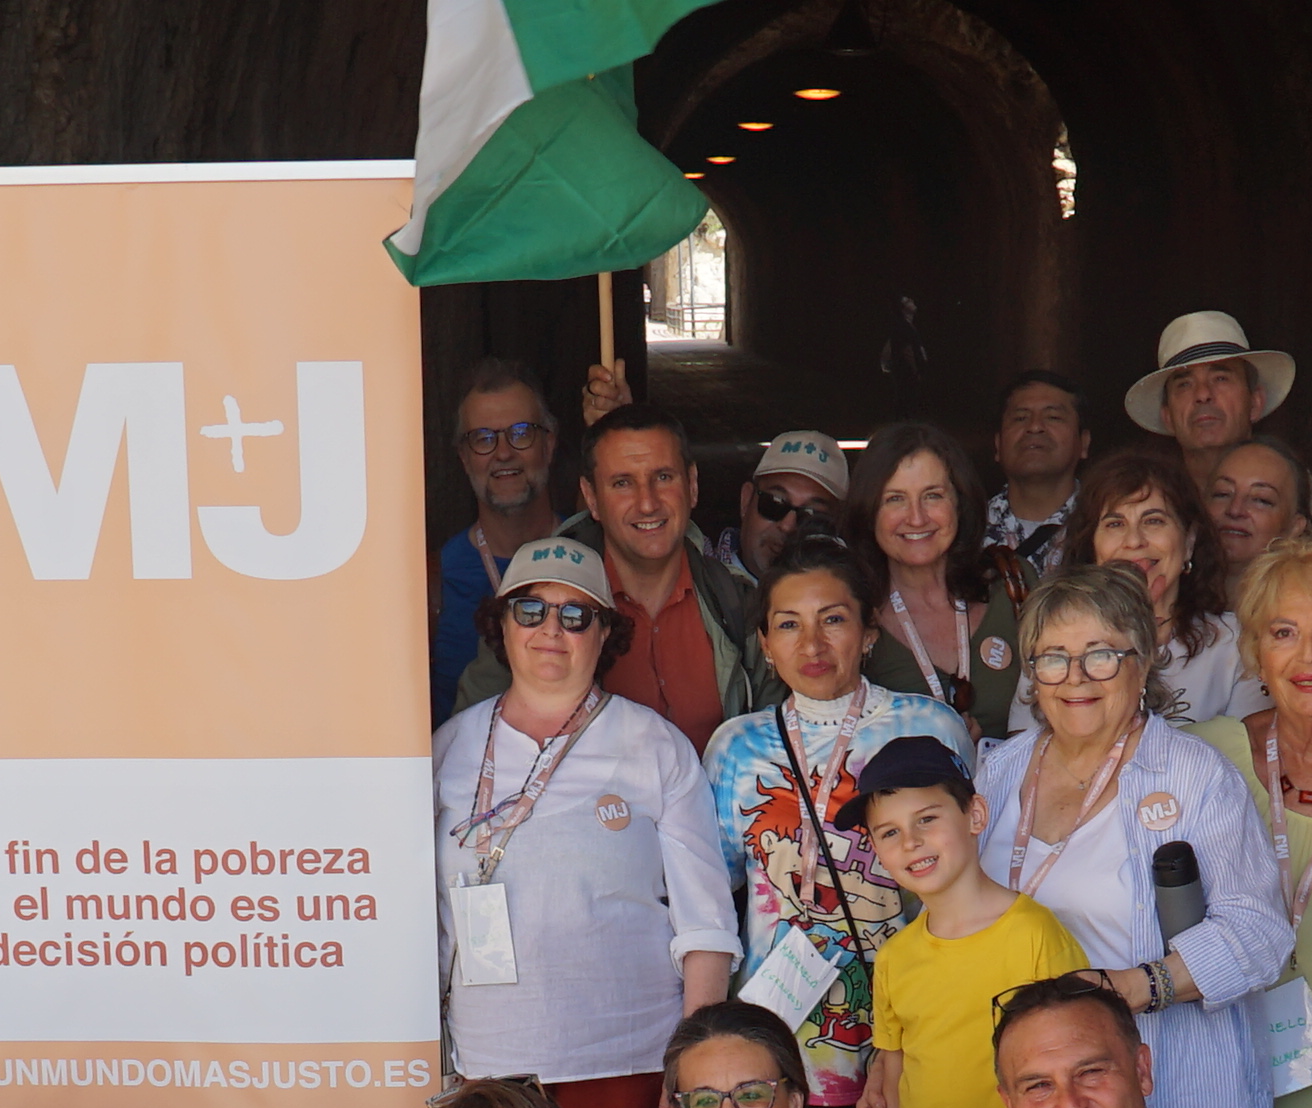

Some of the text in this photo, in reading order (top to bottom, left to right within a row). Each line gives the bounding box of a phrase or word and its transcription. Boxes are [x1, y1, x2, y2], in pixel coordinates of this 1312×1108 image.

[5, 840, 60, 875] fin
[76, 840, 129, 875] de
[143, 840, 178, 875] la
[193, 841, 371, 884] pobreza
[13, 887, 49, 921] el
[66, 887, 216, 922] mundo
[230, 895, 281, 922] es
[296, 893, 378, 921] una
[184, 932, 345, 976] política
